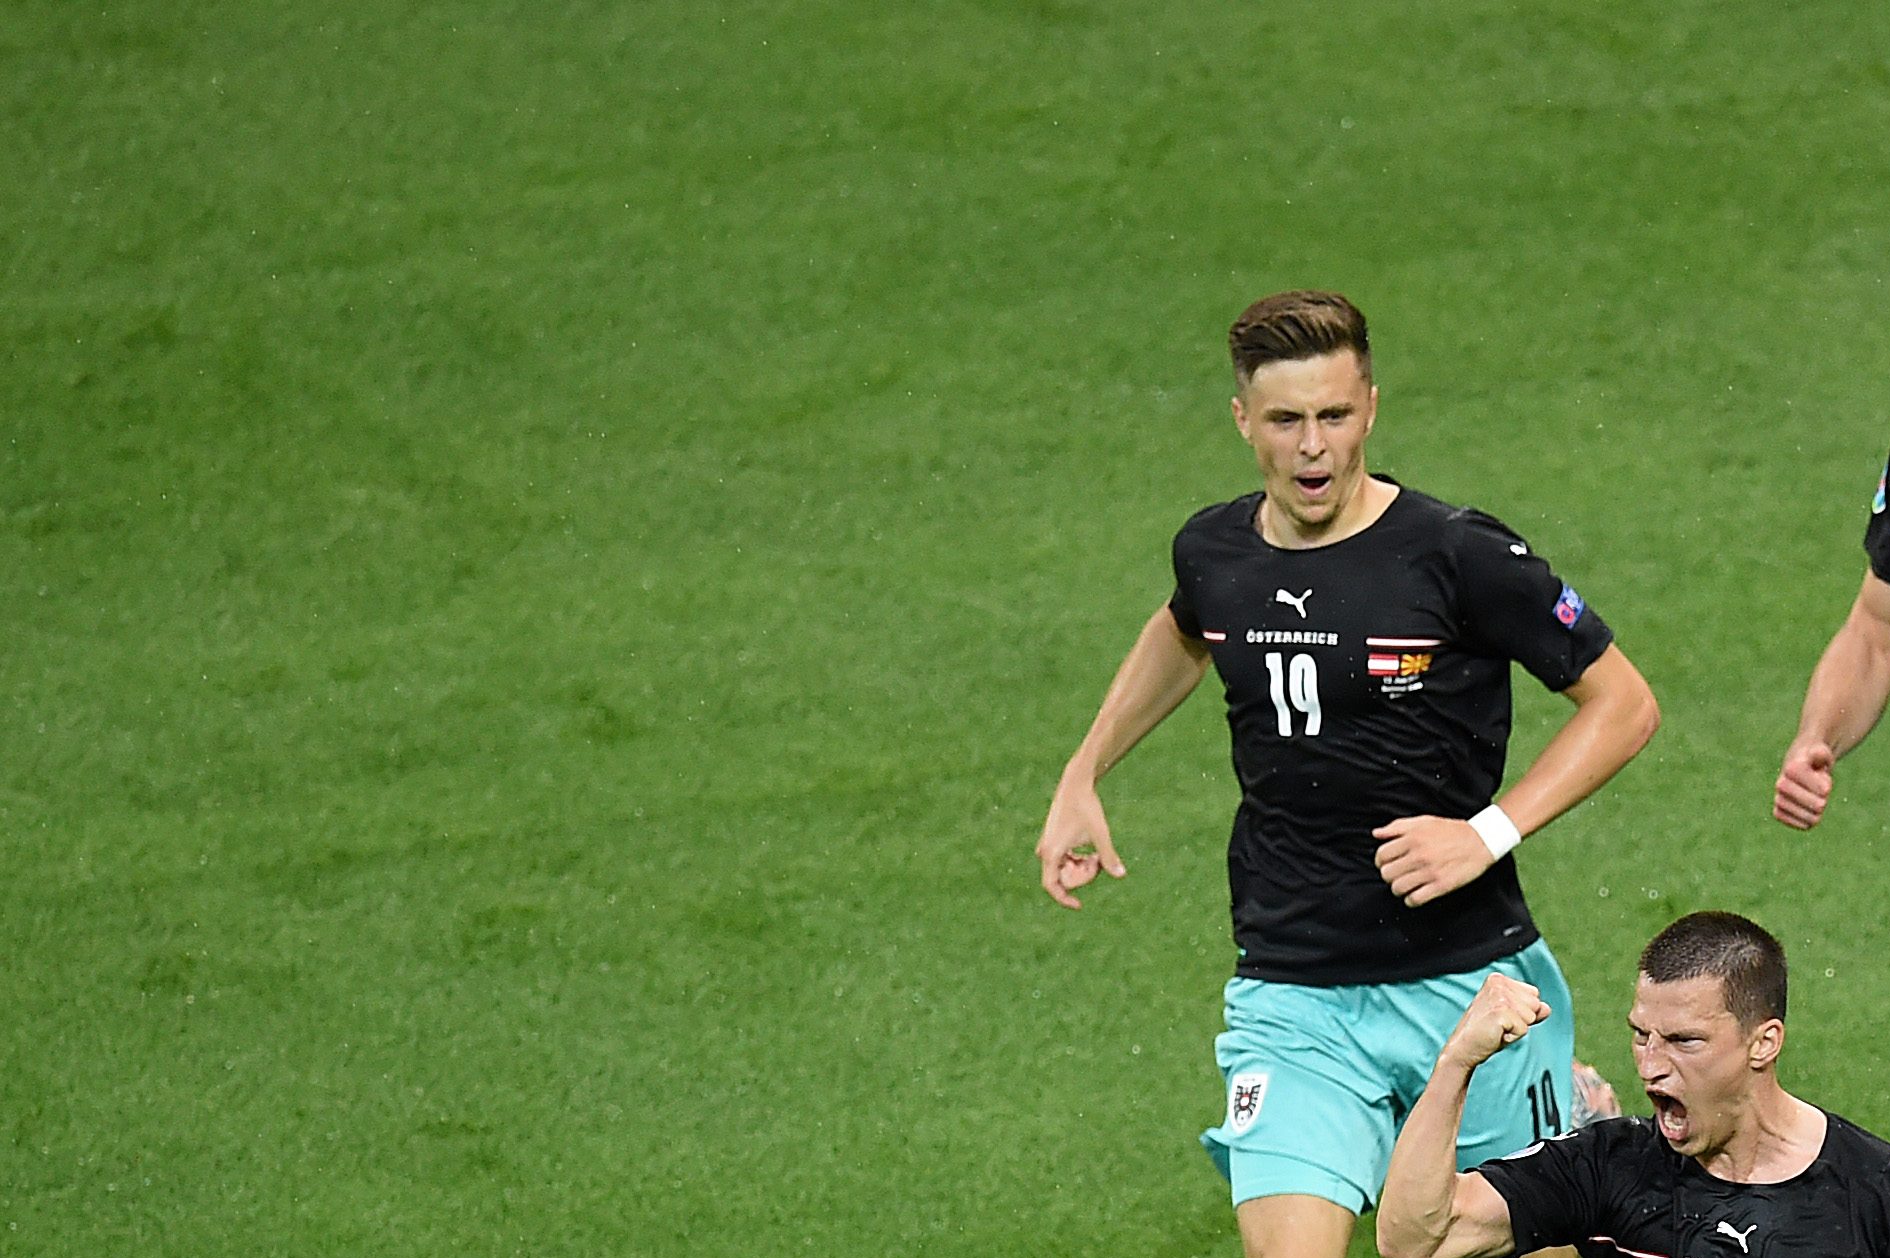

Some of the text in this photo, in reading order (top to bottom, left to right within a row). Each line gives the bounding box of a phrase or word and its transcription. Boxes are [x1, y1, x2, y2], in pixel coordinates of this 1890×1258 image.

[1246, 629, 1339, 646] ÖSTERREICH
[1265, 652, 1322, 737] 19
[1527, 1069, 1561, 1140] 19
